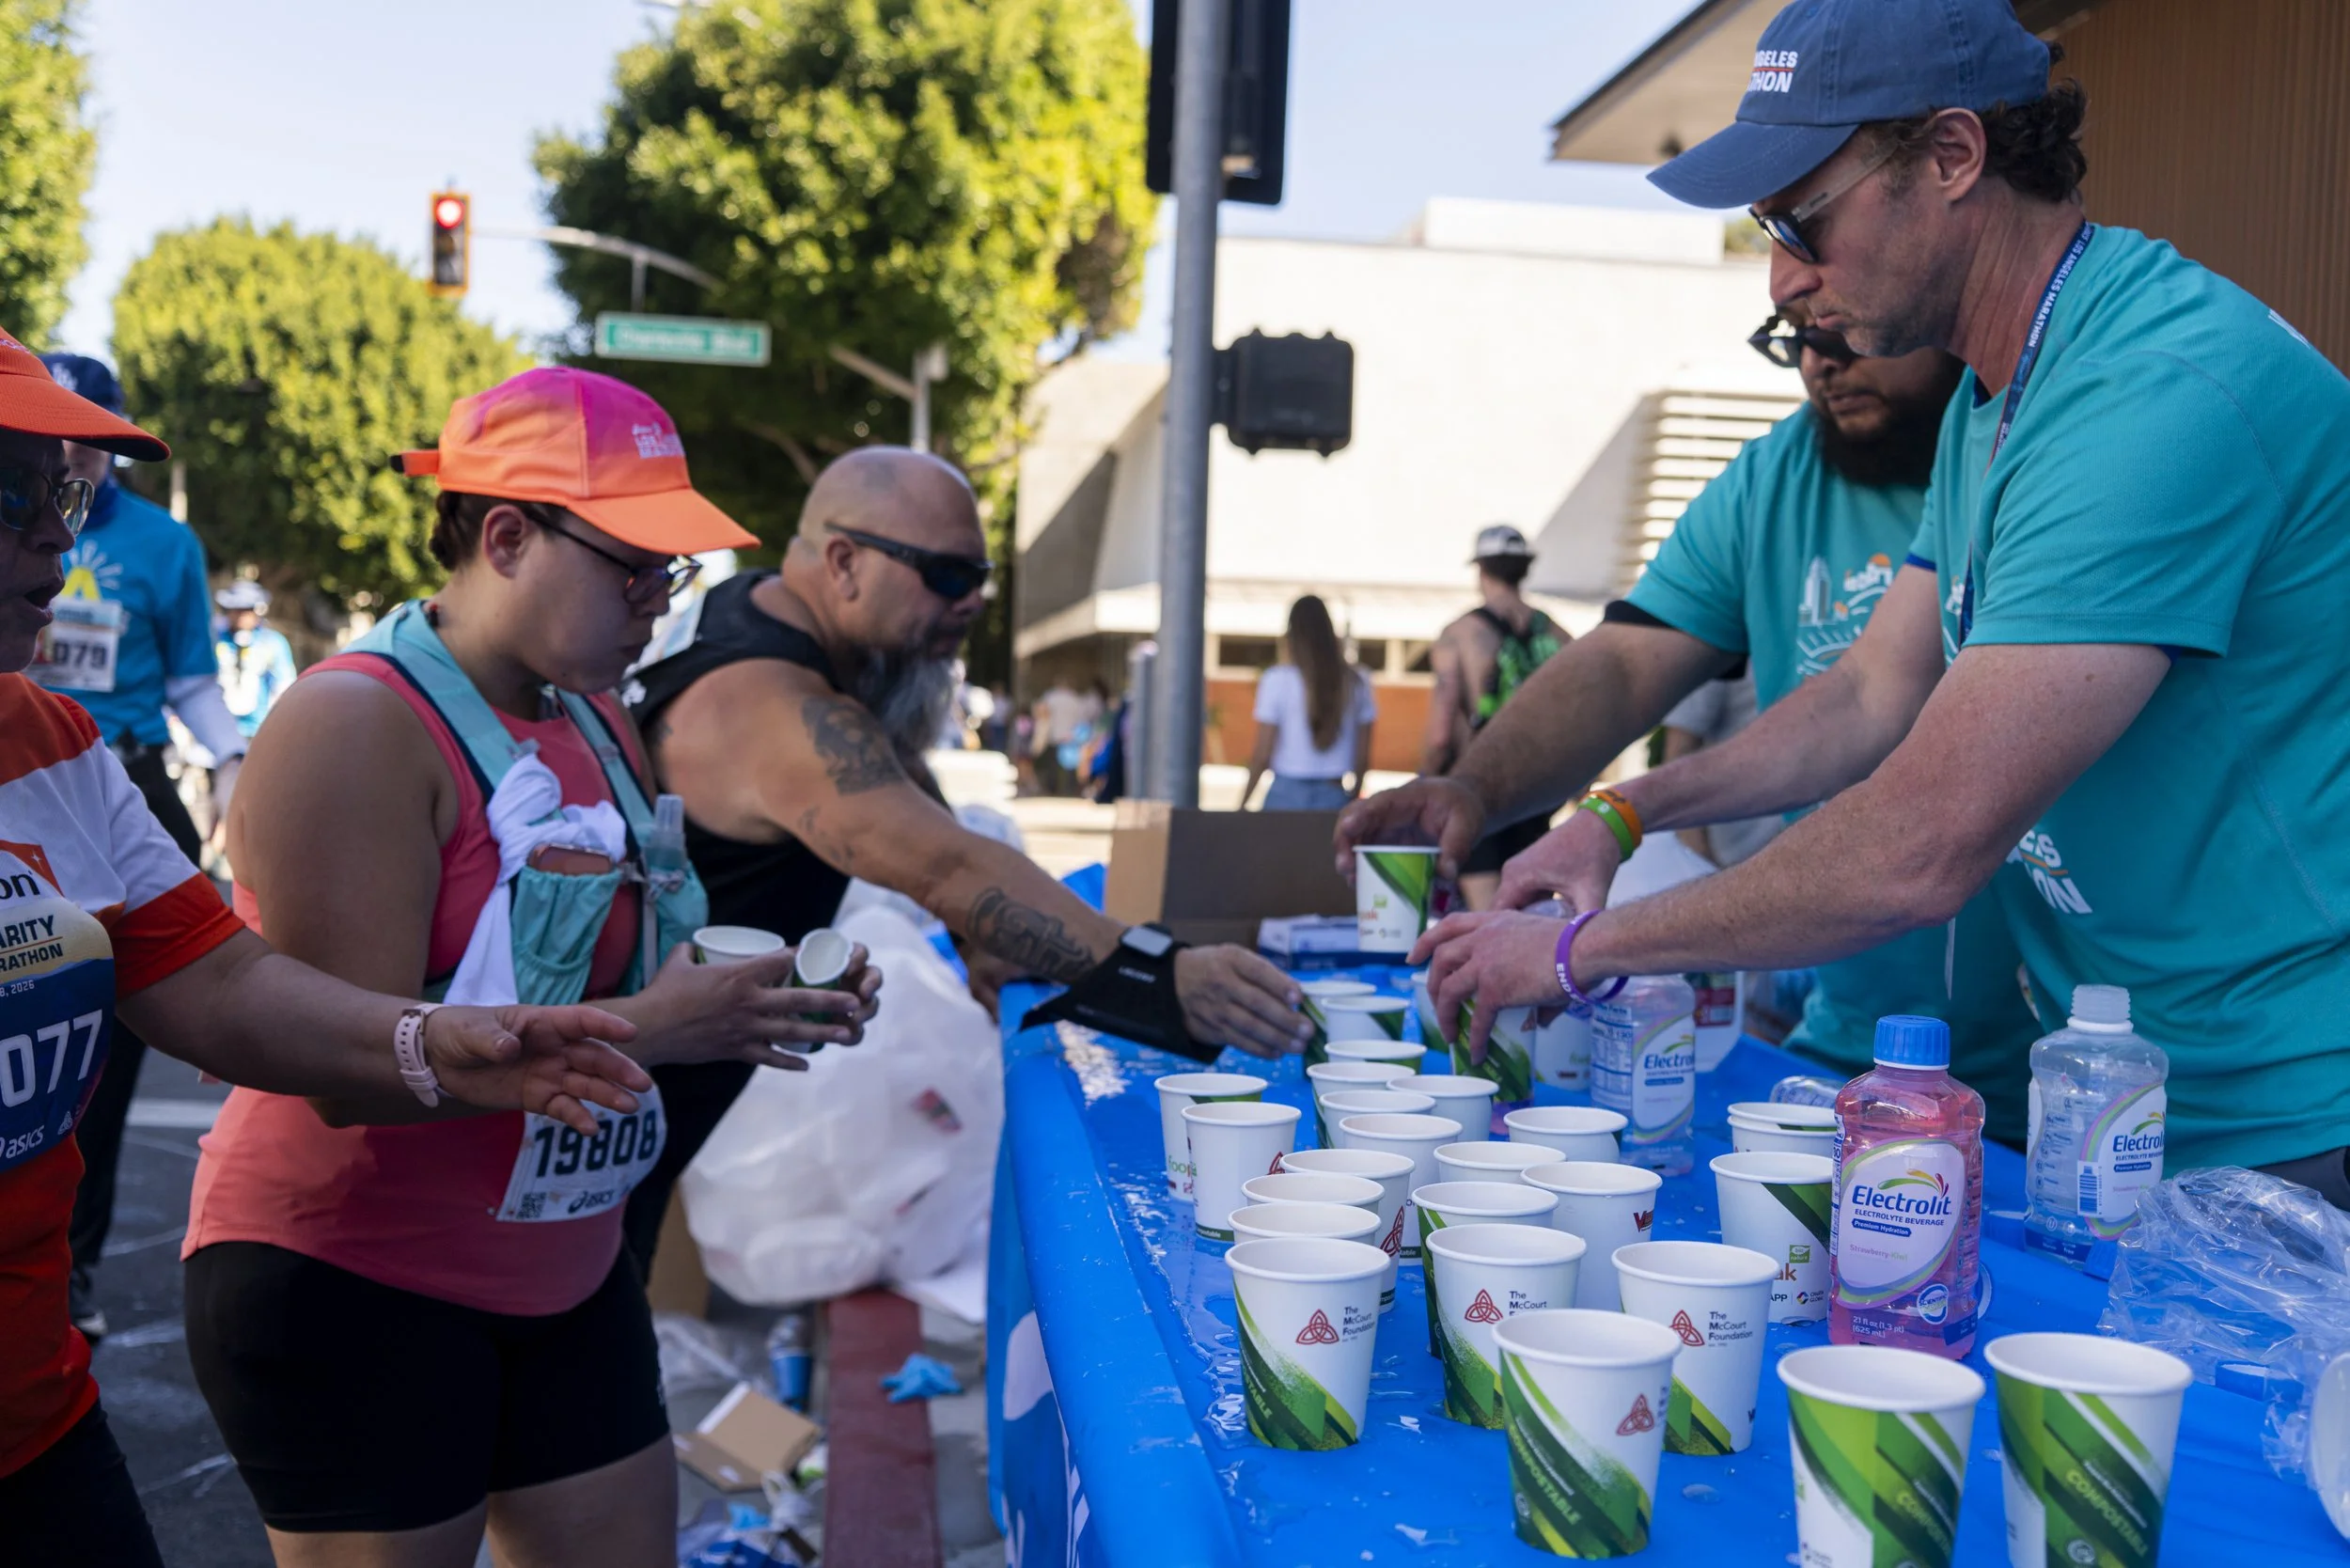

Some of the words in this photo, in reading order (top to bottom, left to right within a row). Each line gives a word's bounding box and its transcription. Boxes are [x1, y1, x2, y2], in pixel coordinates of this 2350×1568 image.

[2051, 252, 2078, 292] ANGELES
[2028, 290, 2057, 349] MARATHON
[1556, 963, 1572, 994] END
[10, 980, 36, 995] 2026
[532, 1110, 657, 1179] 19808
[1852, 1184, 1952, 1215] Electrolit
[1855, 1208, 1904, 1223] ELECTROLYTE
[1904, 1216, 1945, 1226] BEVERAGE
[1854, 1220, 1880, 1231] Premium
[1880, 1225, 1909, 1236] Hydration
[1509, 1291, 1527, 1299] The
[1919, 1294, 1948, 1306] SCIENTIFIC
[1344, 1306, 1359, 1315] The
[1509, 1301, 1547, 1309] McCourt
[1343, 1312, 1372, 1325] McCourt
[1710, 1310, 1727, 1320] The
[1343, 1321, 1375, 1336] Foundation
[1709, 1321, 1747, 1331] McCourt
[1852, 1325, 1871, 1334] (625
[1871, 1329, 1886, 1339] mL)
[1879, 1321, 1893, 1331] (1.3
[1894, 1325, 1904, 1334] pt)
[1709, 1331, 1753, 1341] Foundation
